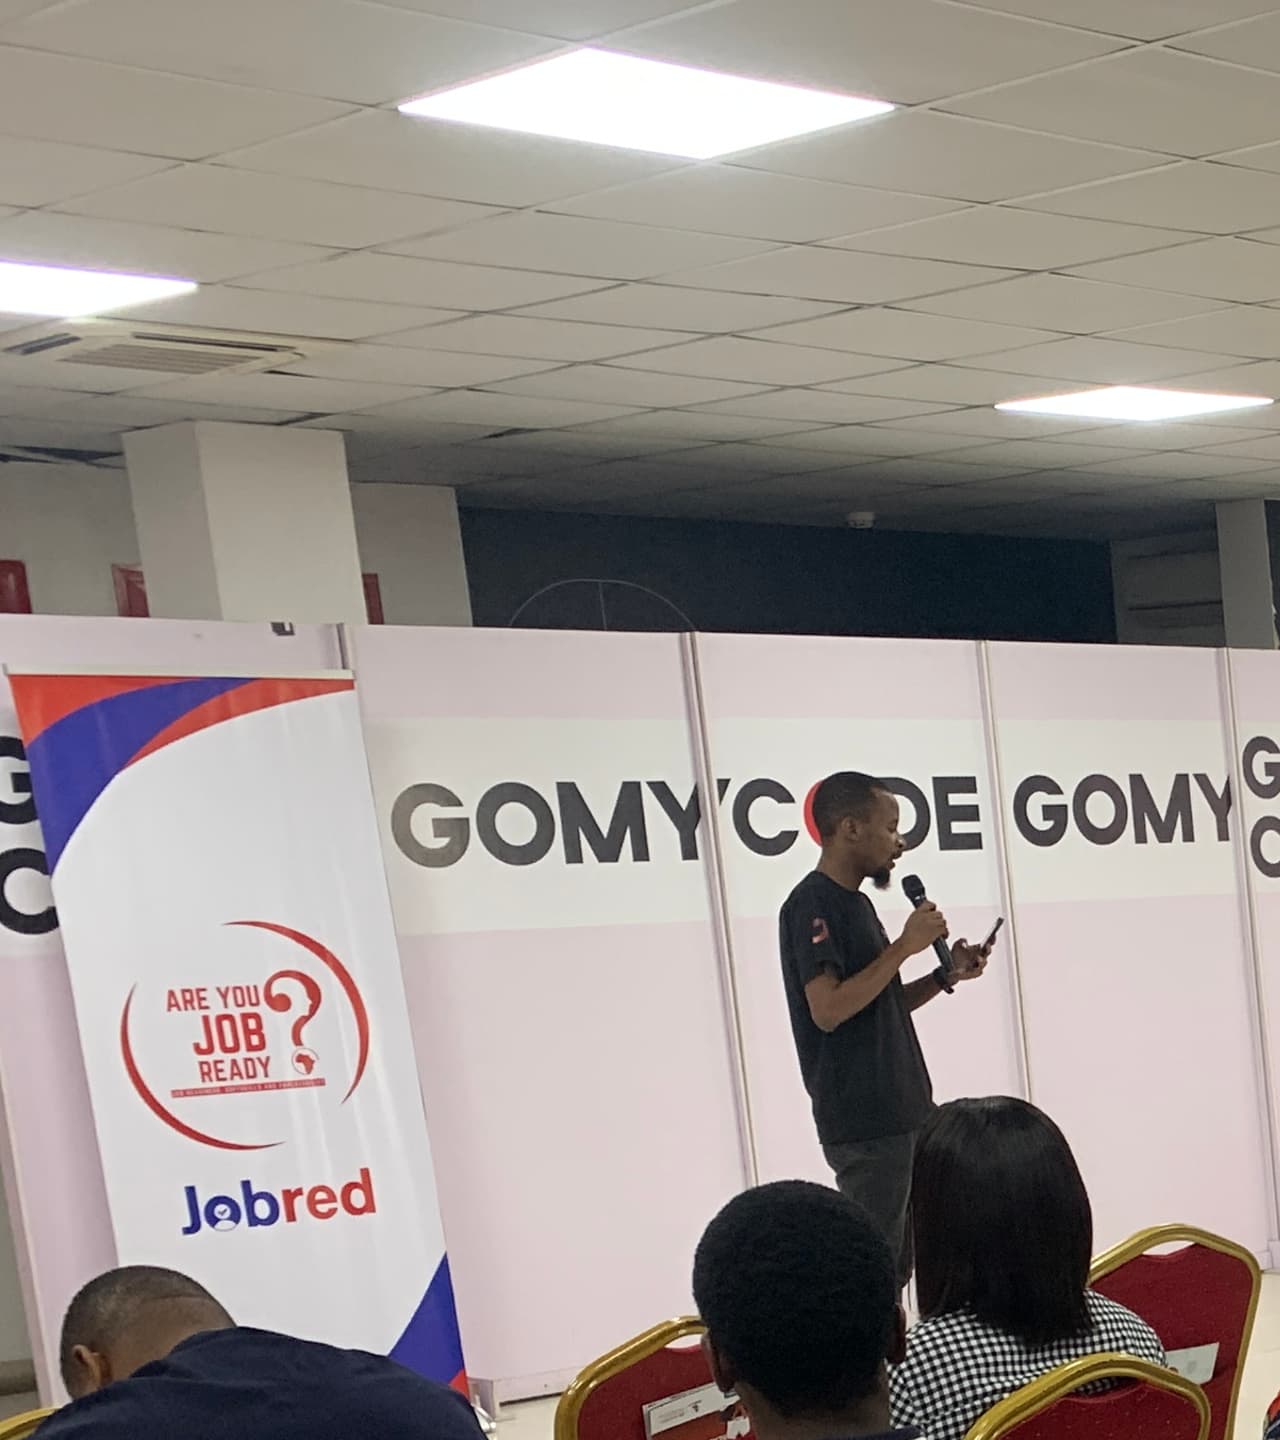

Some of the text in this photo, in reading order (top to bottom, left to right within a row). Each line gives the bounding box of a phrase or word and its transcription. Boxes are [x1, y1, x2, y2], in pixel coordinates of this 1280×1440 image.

[390, 775, 984, 868] GOMYCDE
[1013, 773, 1232, 847] GOMY
[167, 988, 210, 1012] ARE
[215, 985, 261, 1009] YOU
[193, 1012, 267, 1056] JOB
[198, 1056, 271, 1083] READY
[182, 1168, 376, 1235] Jobred
